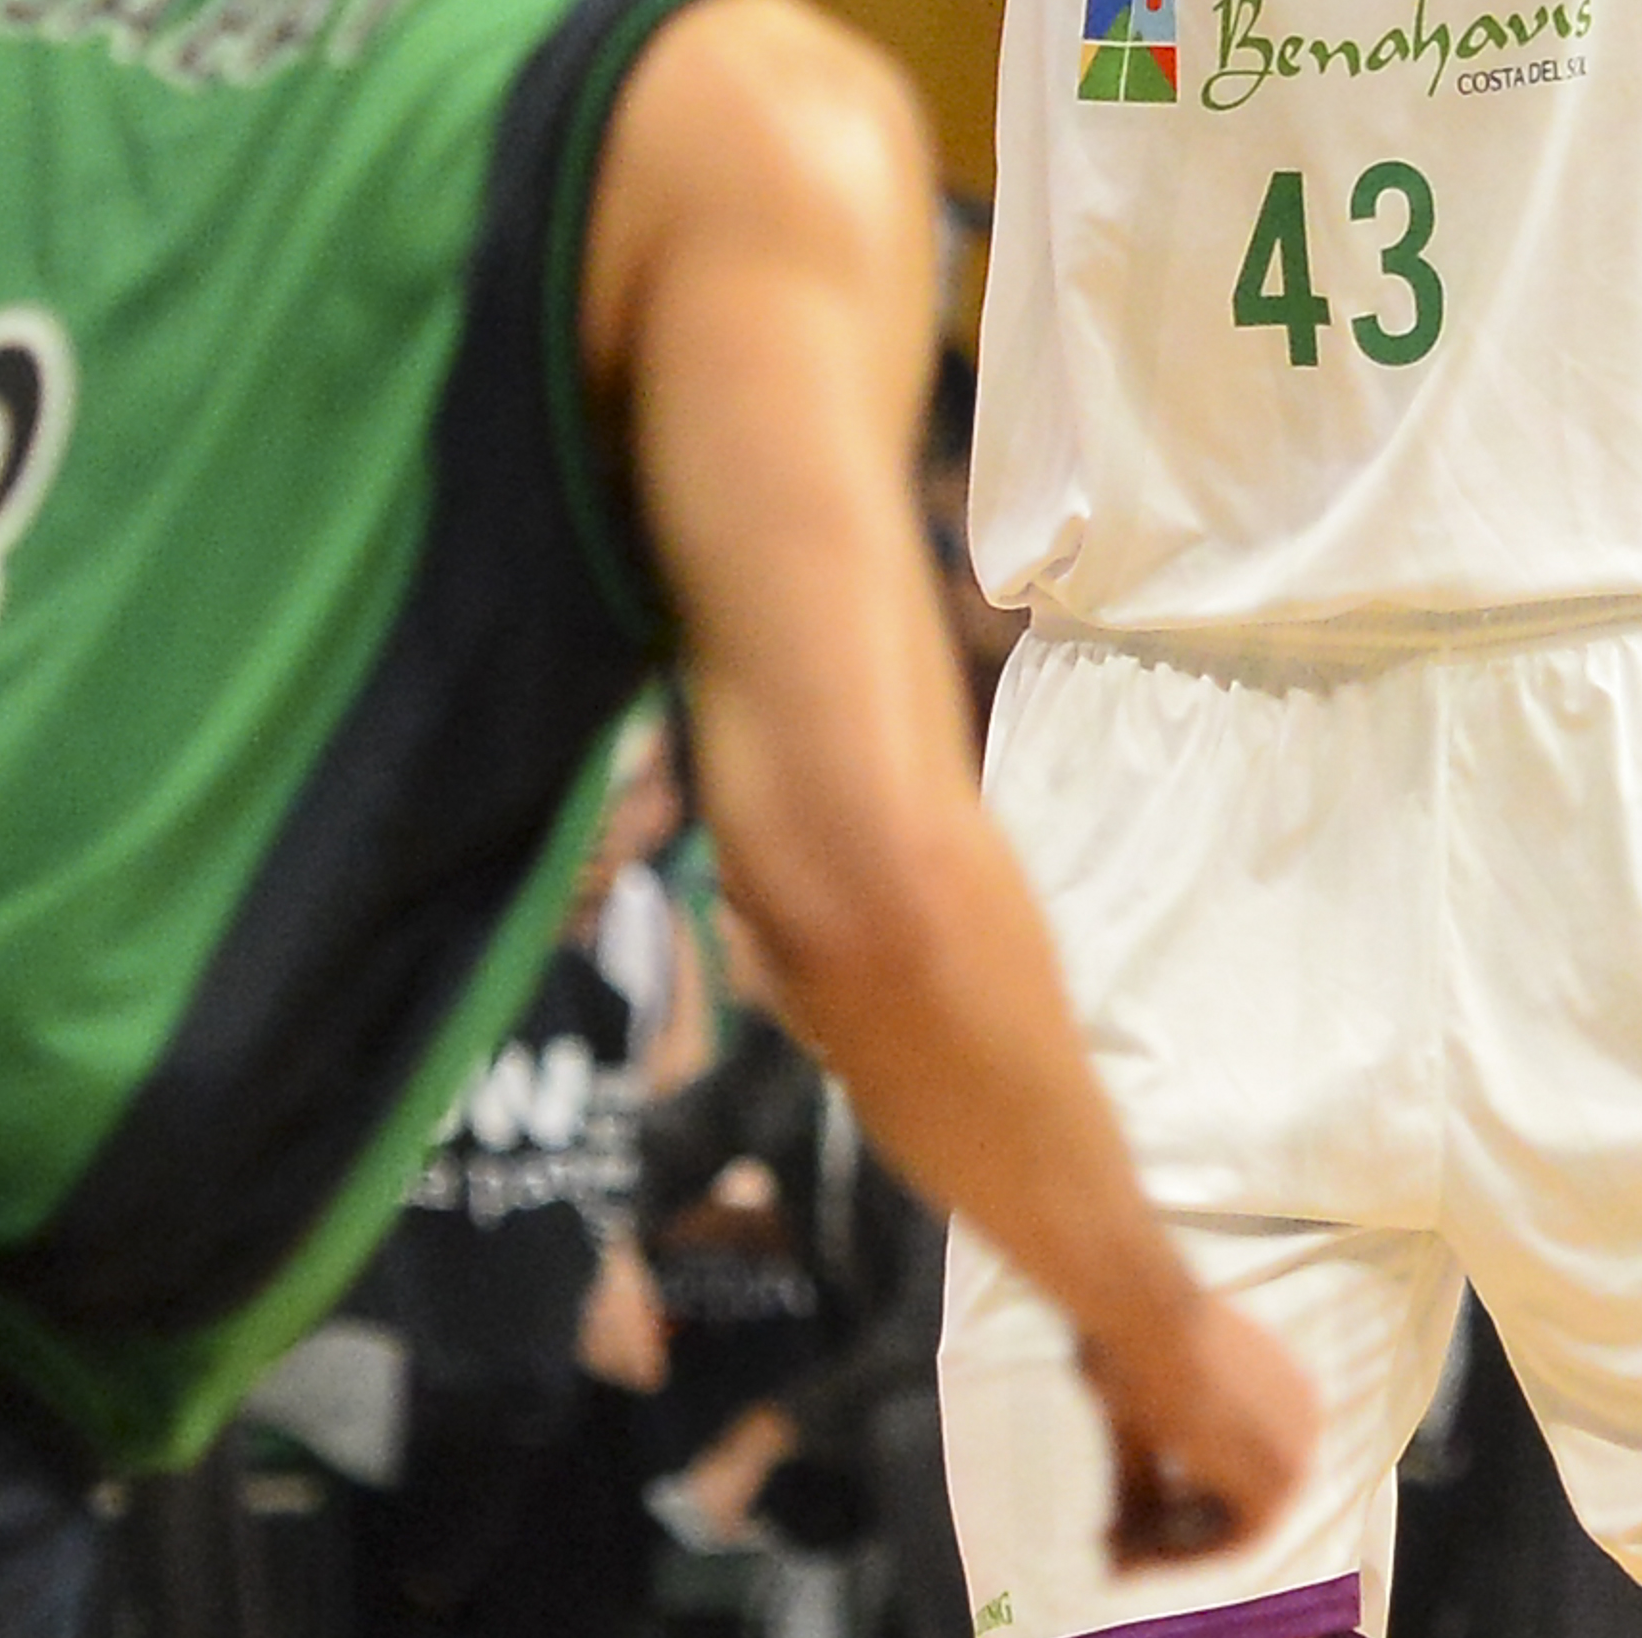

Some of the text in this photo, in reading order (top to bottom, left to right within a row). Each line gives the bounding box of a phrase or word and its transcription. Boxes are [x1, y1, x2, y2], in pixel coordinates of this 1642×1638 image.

[1457, 66, 1525, 96] COSTA
[1528, 60, 1562, 84] DEL
[1231, 160, 1445, 367] 43
